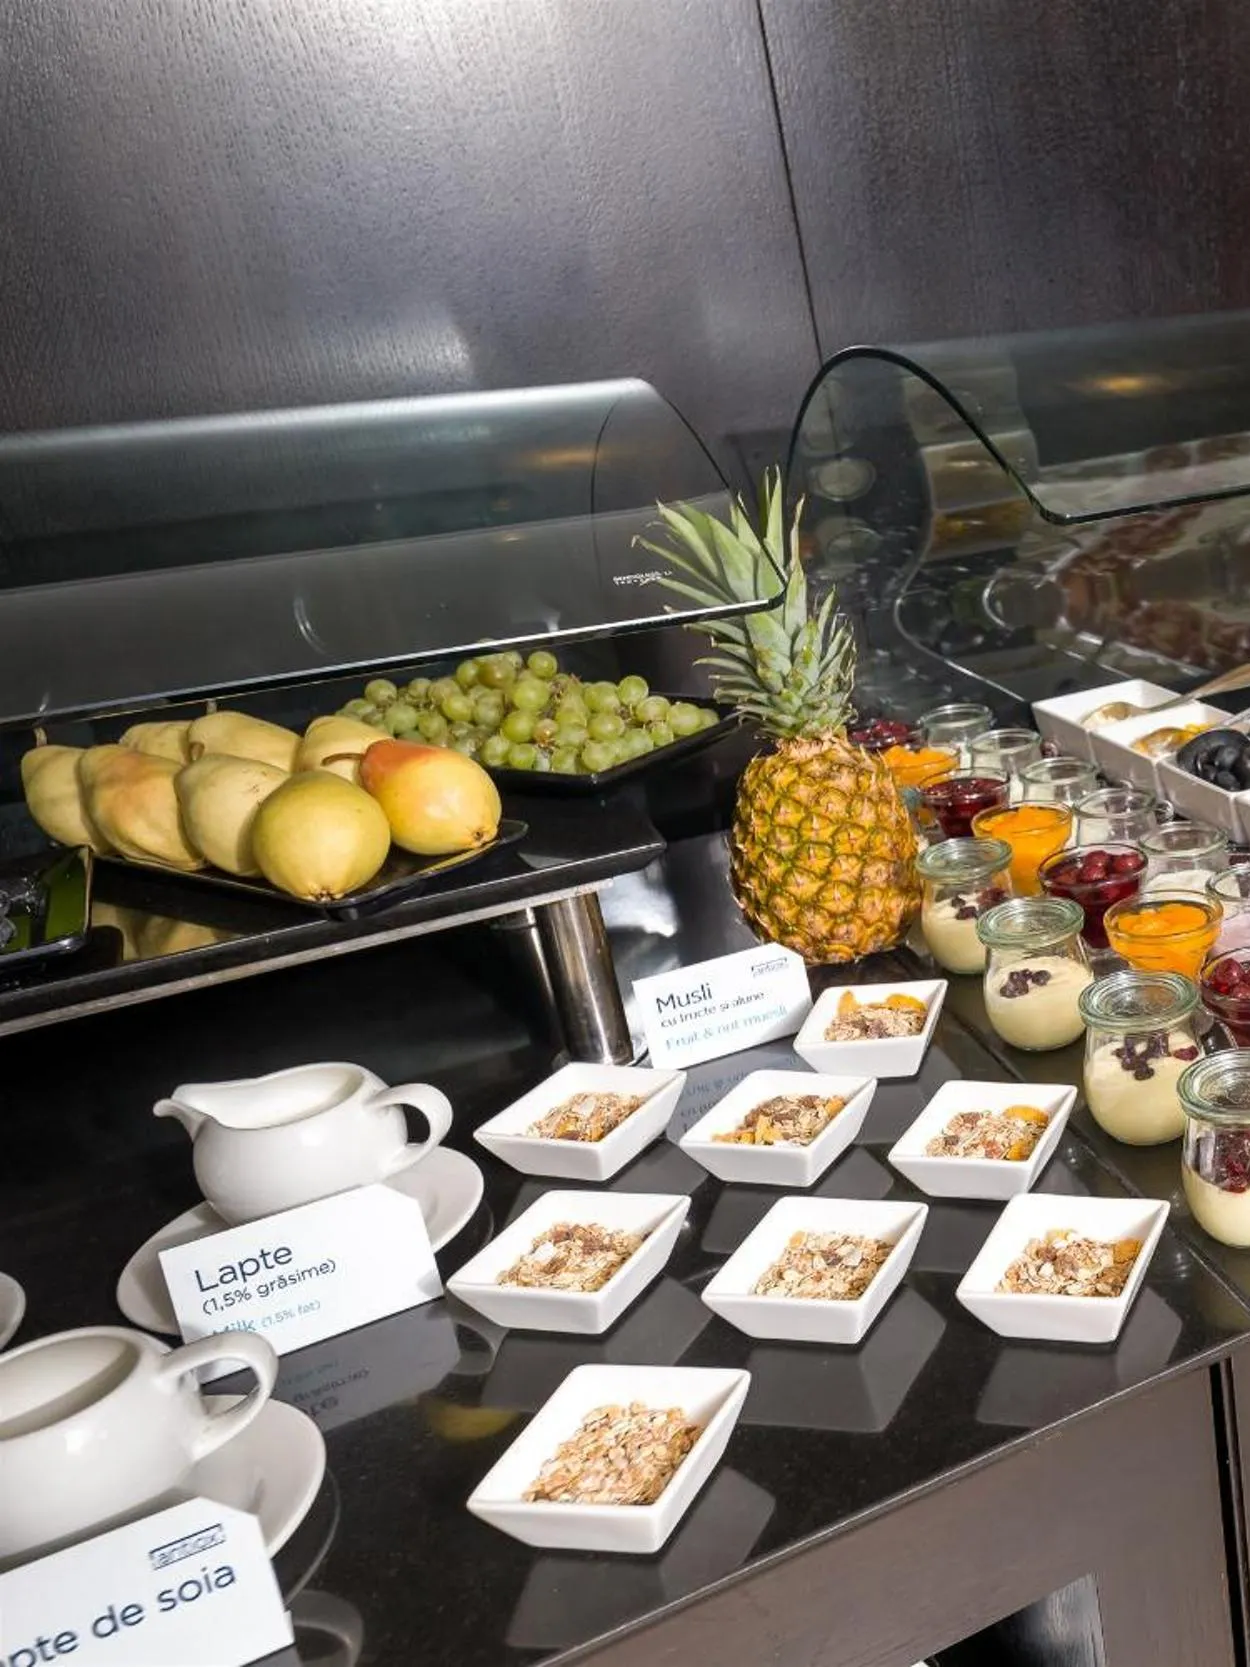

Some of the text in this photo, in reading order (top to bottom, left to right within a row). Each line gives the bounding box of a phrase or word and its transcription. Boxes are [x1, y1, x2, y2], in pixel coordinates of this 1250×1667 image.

[656, 983, 713, 1014] Musli
[194, 1245, 293, 1292] Lapte
[202, 1287, 251, 1315] (1,5%
[212, 1319, 256, 1337] ilk
[0, 1563, 237, 1667] pte de soia
